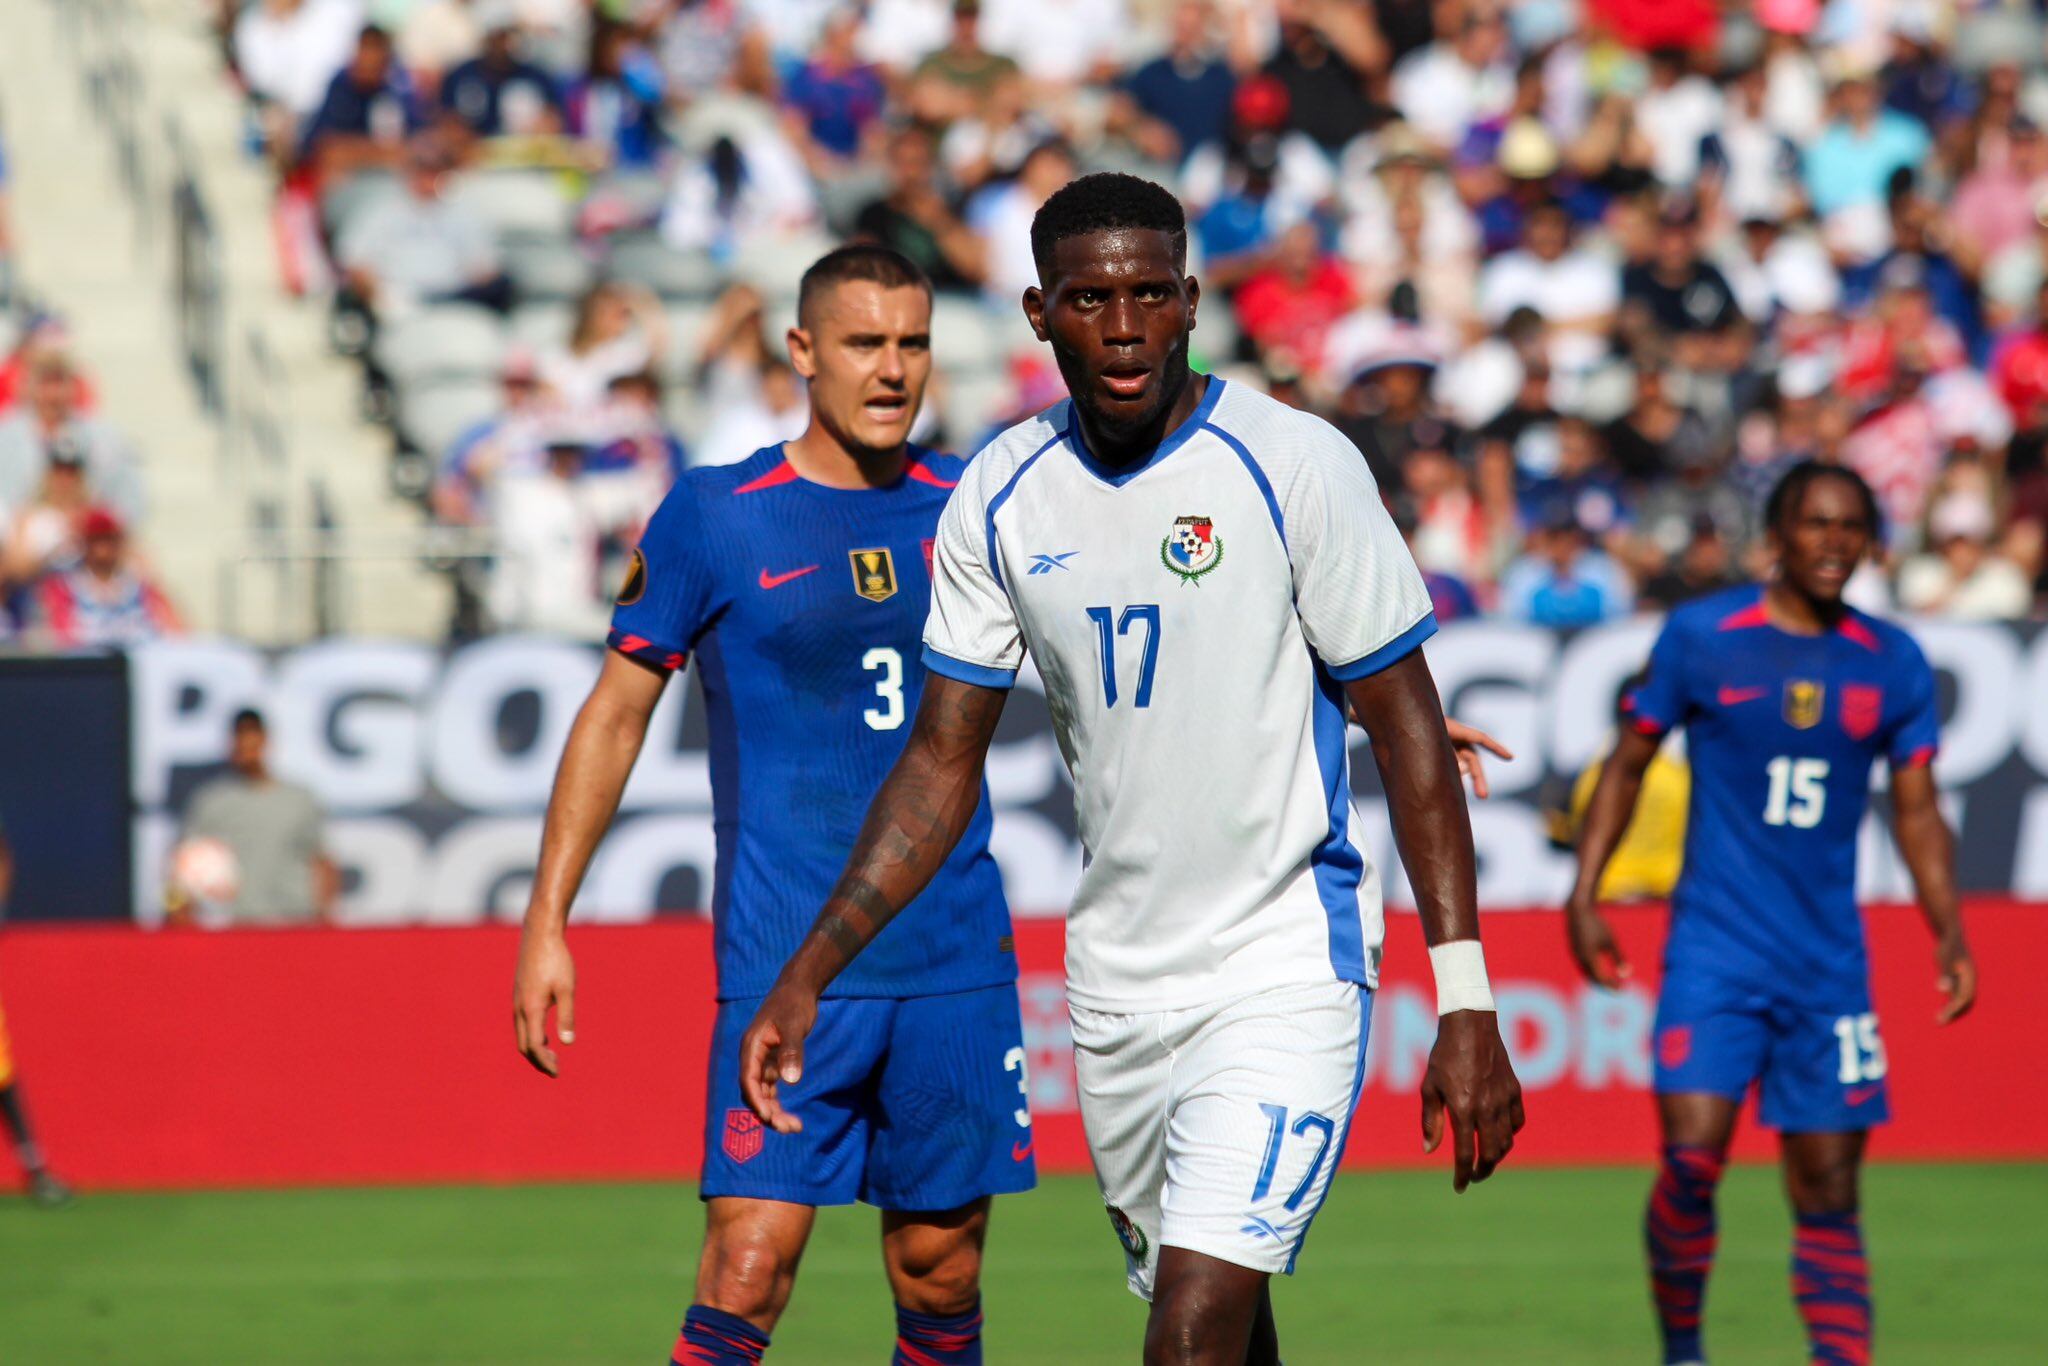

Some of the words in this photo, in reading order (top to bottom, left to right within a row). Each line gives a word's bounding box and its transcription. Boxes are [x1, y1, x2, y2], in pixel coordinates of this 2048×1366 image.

[862, 647, 905, 731] 3
[1085, 604, 1161, 709] 17
[1763, 754, 1831, 829] 15
[1003, 1046, 1032, 1128] 3
[1833, 1012, 1889, 1084] 15
[1250, 1102, 1335, 1214] 17
